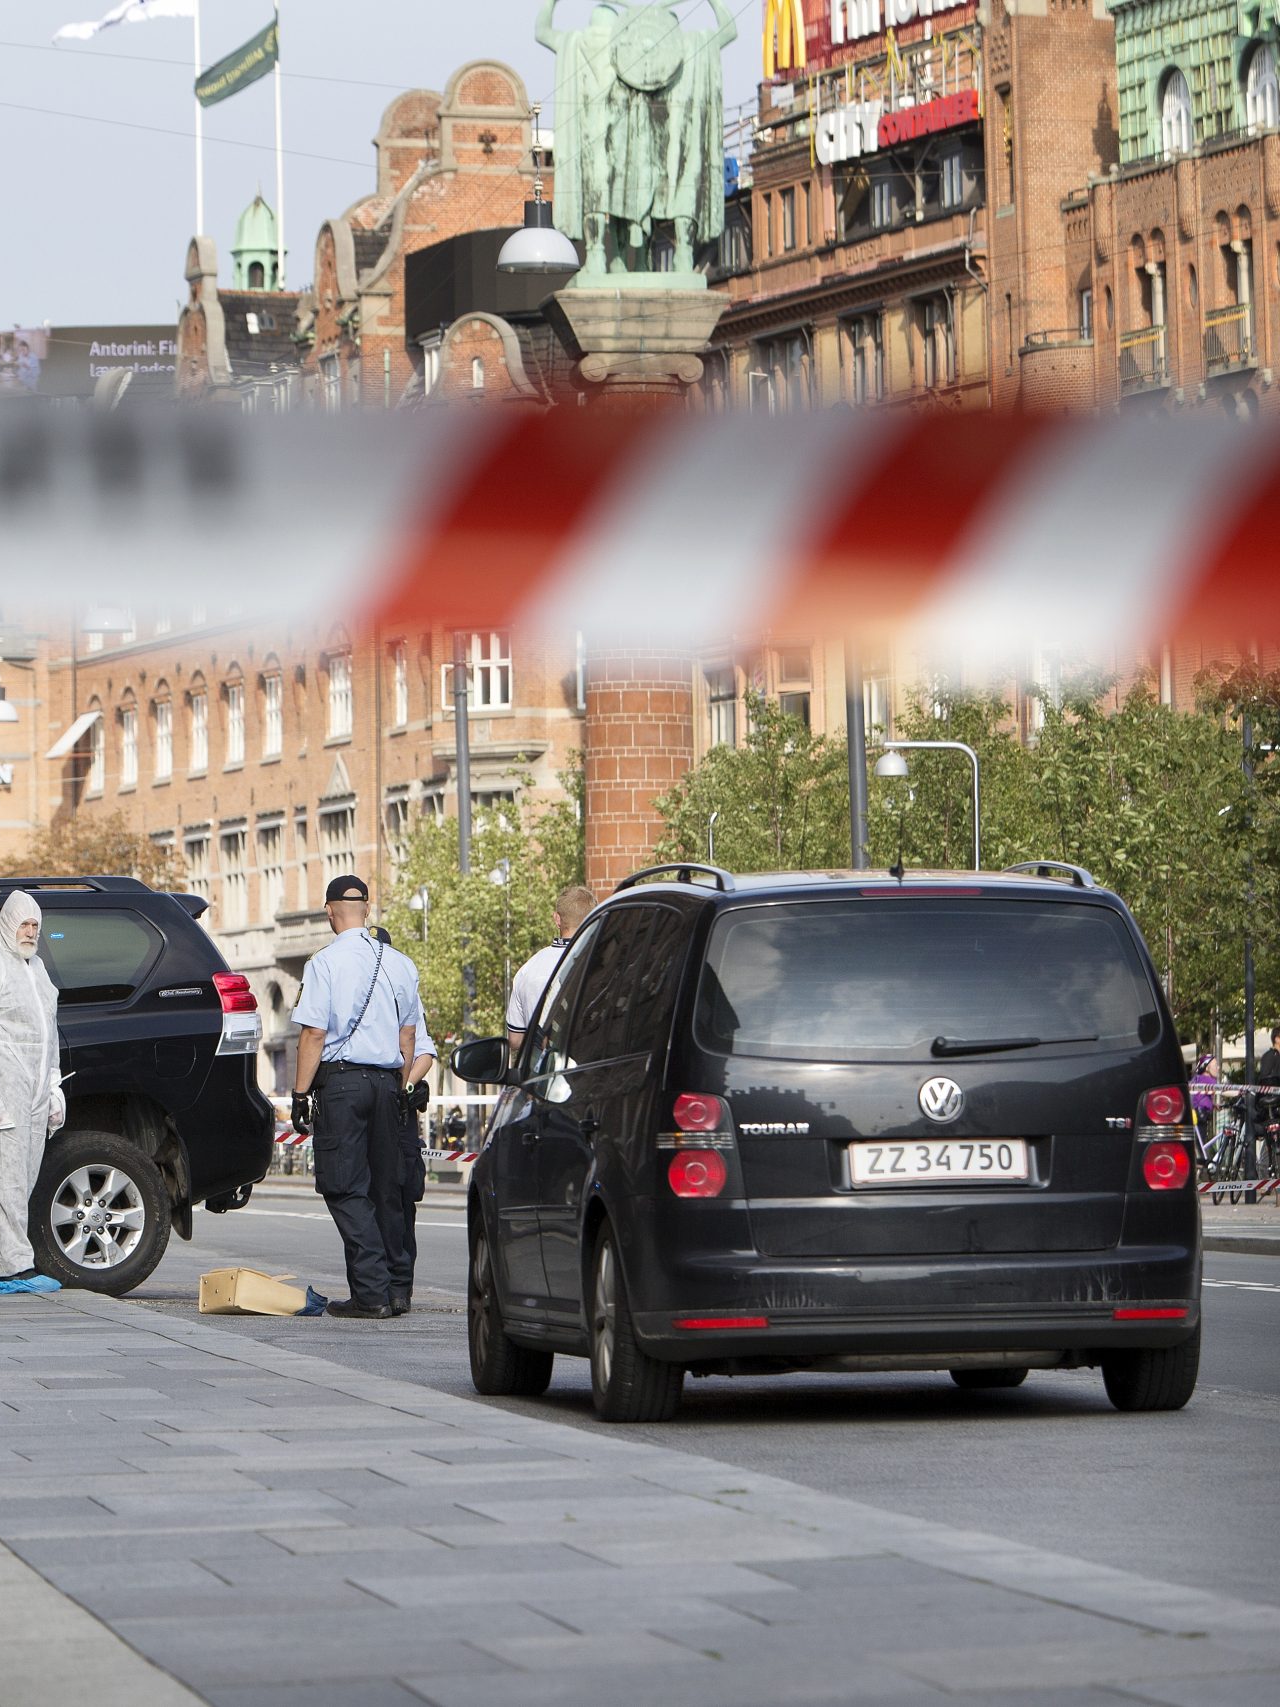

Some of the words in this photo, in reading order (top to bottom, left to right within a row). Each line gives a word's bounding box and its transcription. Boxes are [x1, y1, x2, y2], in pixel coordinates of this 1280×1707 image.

[815, 99, 881, 165] CITY
[89, 340, 156, 356] Antorini:
[739, 1122, 810, 1136] TOURAN
[867, 1147, 907, 1175] ZZ
[916, 1145, 953, 1172] 34
[958, 1143, 1013, 1171] 750
